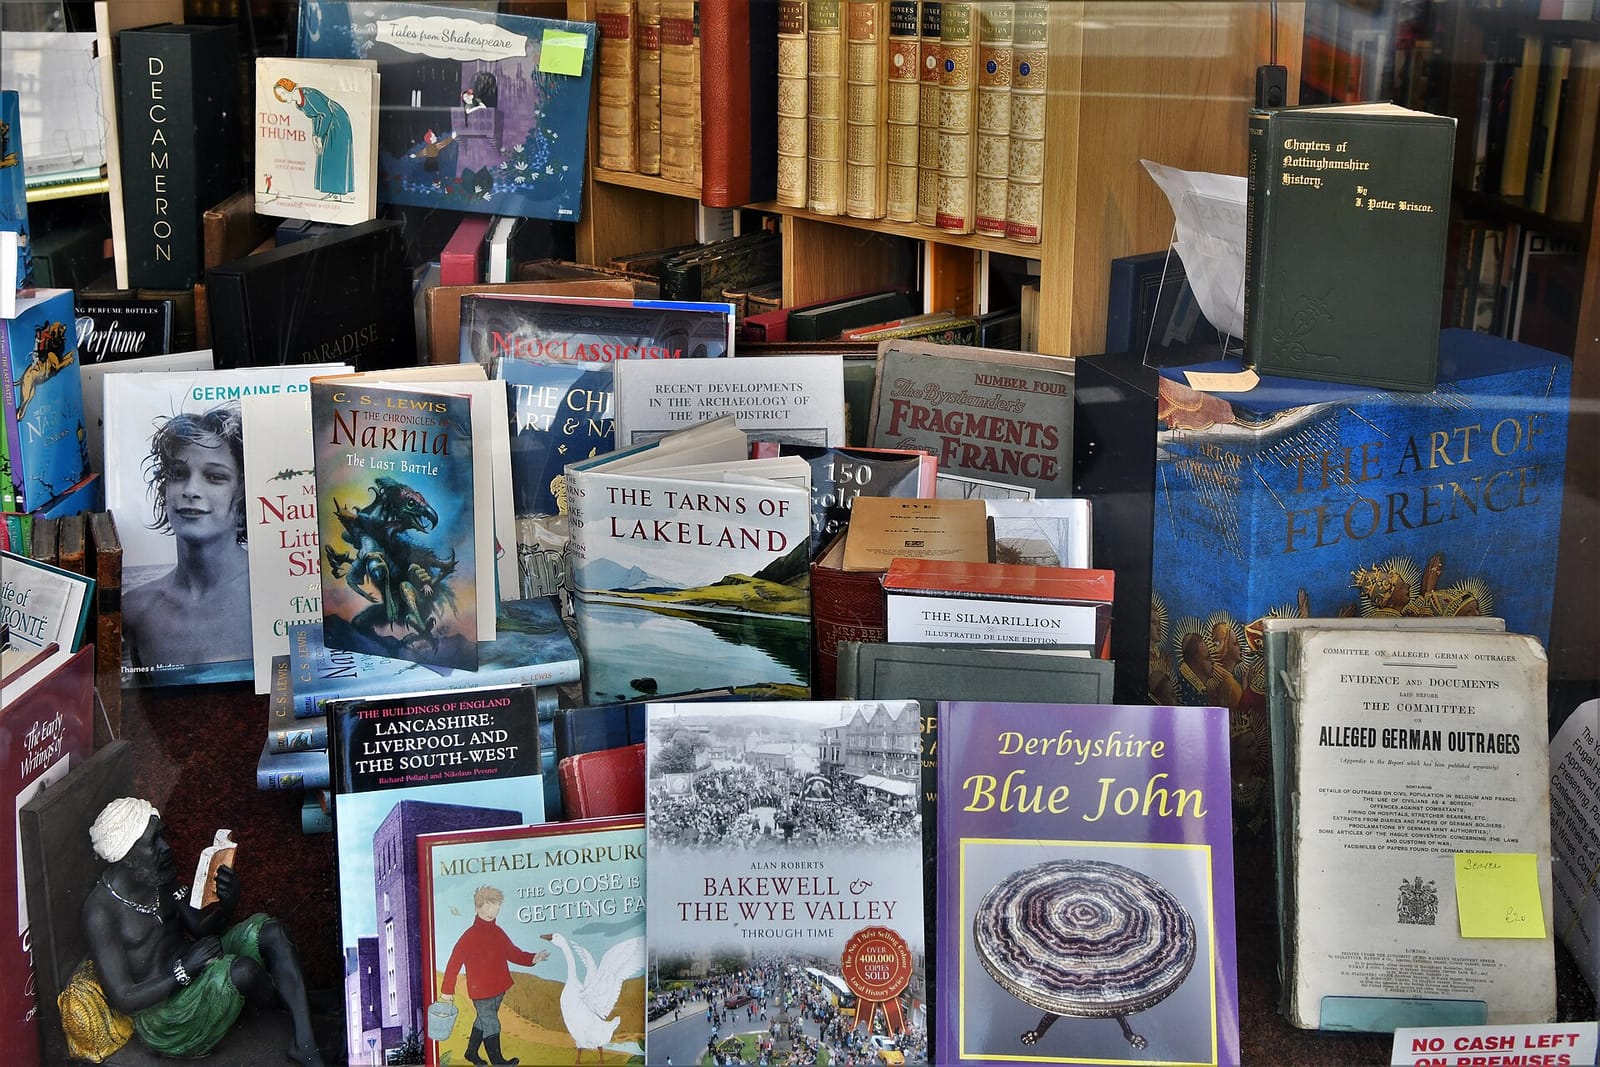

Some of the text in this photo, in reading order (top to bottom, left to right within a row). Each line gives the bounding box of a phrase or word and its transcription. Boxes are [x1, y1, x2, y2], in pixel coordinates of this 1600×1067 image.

[390, 23, 418, 39] Tales
[420, 28, 439, 42] from
[441, 29, 513, 49] Shakespeare
[259, 112, 290, 126] TOM
[260, 127, 306, 142] THUMB
[1283, 139, 1348, 153] Chapters of
[147, 56, 173, 262] DECAMERON
[1282, 155, 1370, 172] Nottinghamshire
[1282, 172, 1325, 189] History.
[1356, 186, 1368, 196] By
[1367, 198, 1396, 211] Potter
[75, 315, 147, 362] Perfume
[303, 323, 378, 363] PARADISE
[655, 382, 804, 394] RECENT DEVELOPMENTS
[974, 373, 1067, 396] NUMBER FOUR
[333, 392, 448, 413] C. S. LEWIS
[511, 383, 558, 409] THE
[649, 395, 810, 408] IN THE ARCHAEOLOGY OF
[921, 381, 1025, 414] Bystander's
[364, 411, 436, 426] THE CHRONICLES
[563, 416, 580, 435] &
[668, 410, 692, 421] THE
[736, 410, 791, 420] DISTRICT
[885, 398, 1060, 450] FRAGMENTS
[936, 436, 1059, 482] FRANCE
[1285, 412, 1548, 495] THE ART OF
[823, 462, 873, 486] 150
[606, 486, 790, 518] THE TARNS OF
[1282, 463, 1545, 556] FLORENCE
[611, 515, 788, 553] LAKELAND
[17, 589, 31, 607] of
[921, 610, 1062, 629] THE SILMARILLION
[925, 629, 981, 640] ILLUSTRATED
[997, 634, 1020, 643] LUXE
[1022, 636, 1058, 645] EDITION
[1323, 648, 1370, 657] COMMITTEE
[1392, 651, 1430, 659] ALLEGED
[1434, 653, 1470, 661] GERMAN
[120, 666, 149, 674] Thames
[277, 663, 288, 691] LEWIS
[1339, 674, 1400, 686] EVIDENCE
[1429, 678, 1500, 690] DOCUMENTS
[356, 697, 511, 721] THE BUILDINGS OF ENGLAND
[1363, 701, 1476, 715] THE COMMITTEE
[23, 711, 64, 751] The Early
[374, 712, 496, 737] LANCASHIRE:
[1580, 725, 1594, 746] The
[363, 729, 508, 757] LIVERPOOL AND
[997, 729, 1165, 765] Derbyshire
[1318, 726, 1521, 755] ALLEGED GERMAN OUTRAGES
[21, 742, 55, 779] Writings
[355, 745, 519, 775] THE SOUTH-WEST
[1572, 738, 1595, 770] Frugal
[378, 766, 498, 785] Richard Pollard and Nikolaus Pevsner
[961, 769, 1209, 823] Blue John
[439, 853, 541, 877] MICHAEL
[750, 861, 825, 870] ALAN ROBERTS
[516, 871, 641, 899] THE GOOSE IS
[703, 876, 874, 898] BAKEWELL &
[516, 897, 617, 924] GETTING
[677, 900, 898, 922] THE WYE VALLEY
[741, 928, 835, 939] THROUGH TIME
[860, 954, 895, 964] 400,000
[866, 946, 887, 954] OVER
[864, 964, 890, 972] COPIES
[864, 971, 890, 980] SOLD
[1411, 1033, 1580, 1052] NO CASH LEFT
